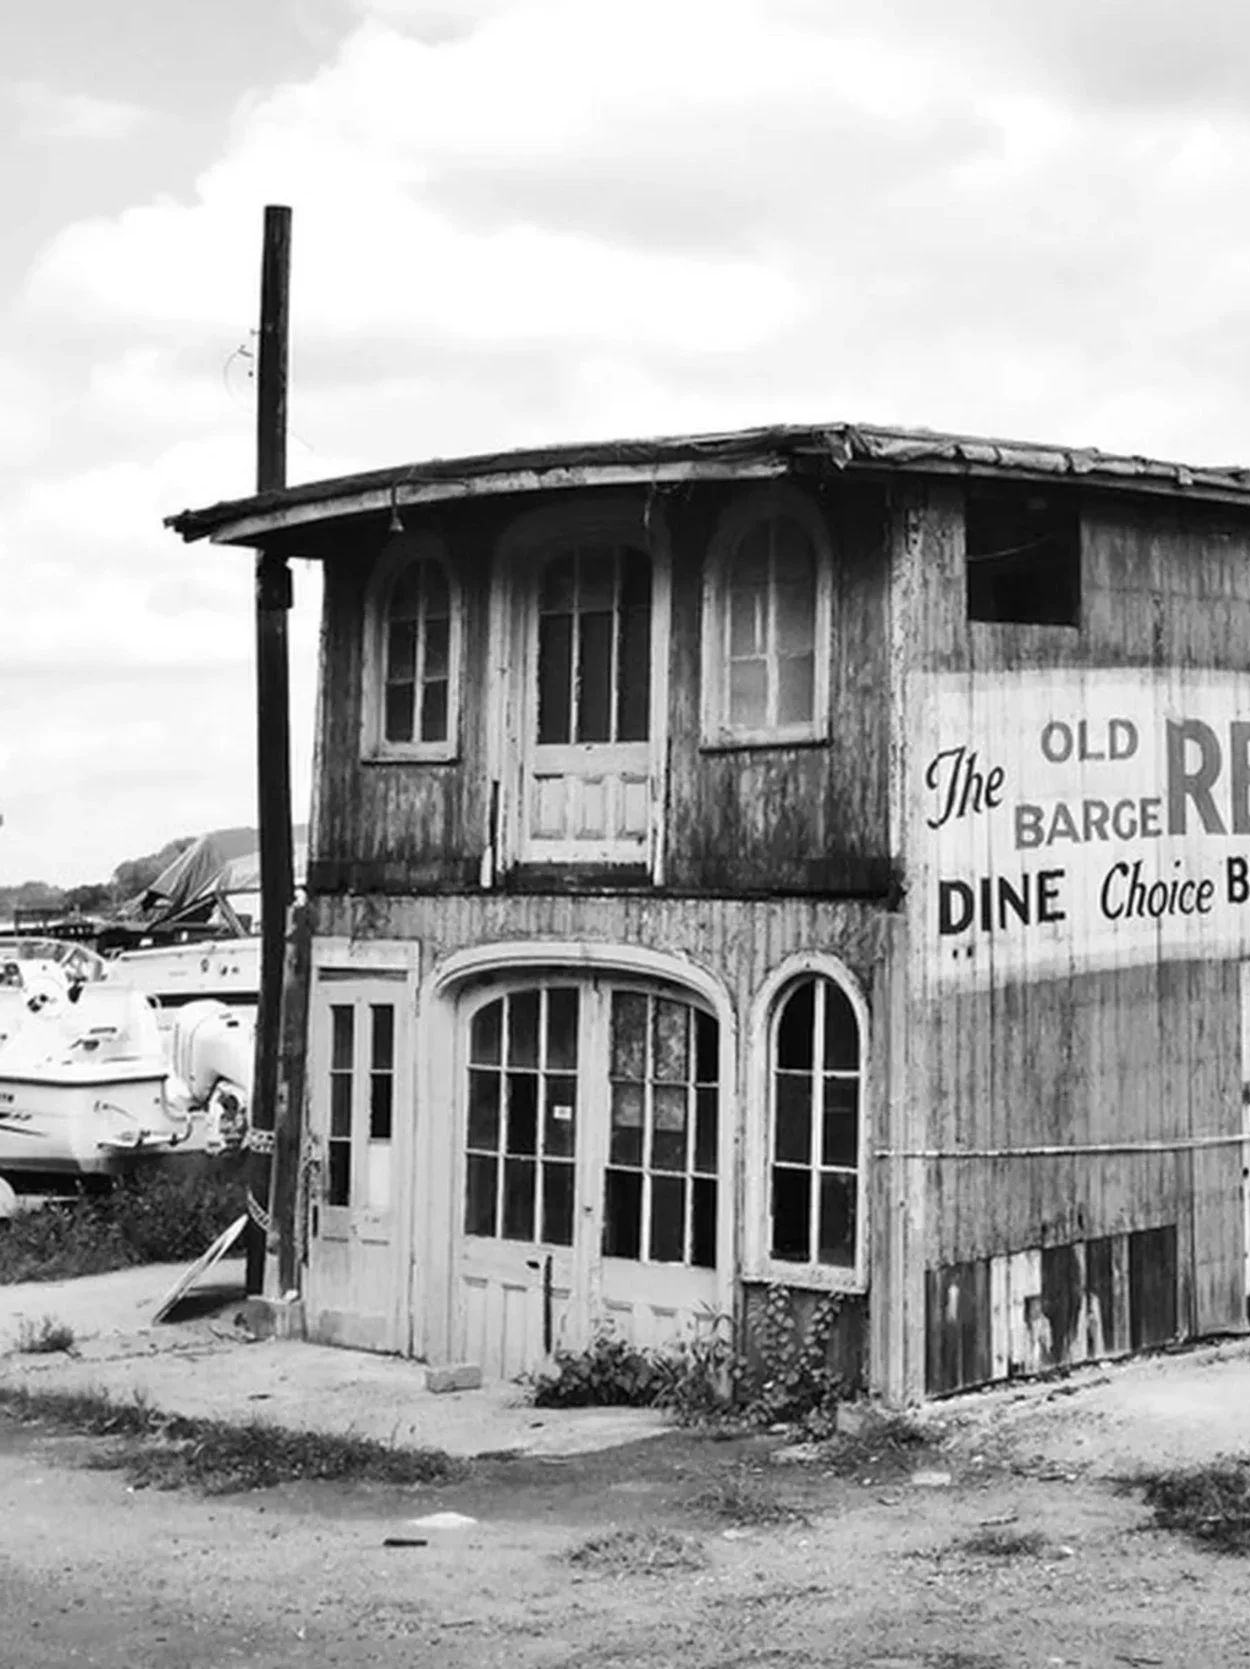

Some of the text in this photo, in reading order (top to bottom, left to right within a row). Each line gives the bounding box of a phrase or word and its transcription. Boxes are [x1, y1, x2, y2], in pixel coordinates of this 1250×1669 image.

[1041, 719, 1138, 763] OLD
[927, 746, 1004, 829] The
[1014, 798, 1163, 850] BARGE
[938, 869, 1066, 935] DINE
[1100, 859, 1214, 920] Choice
